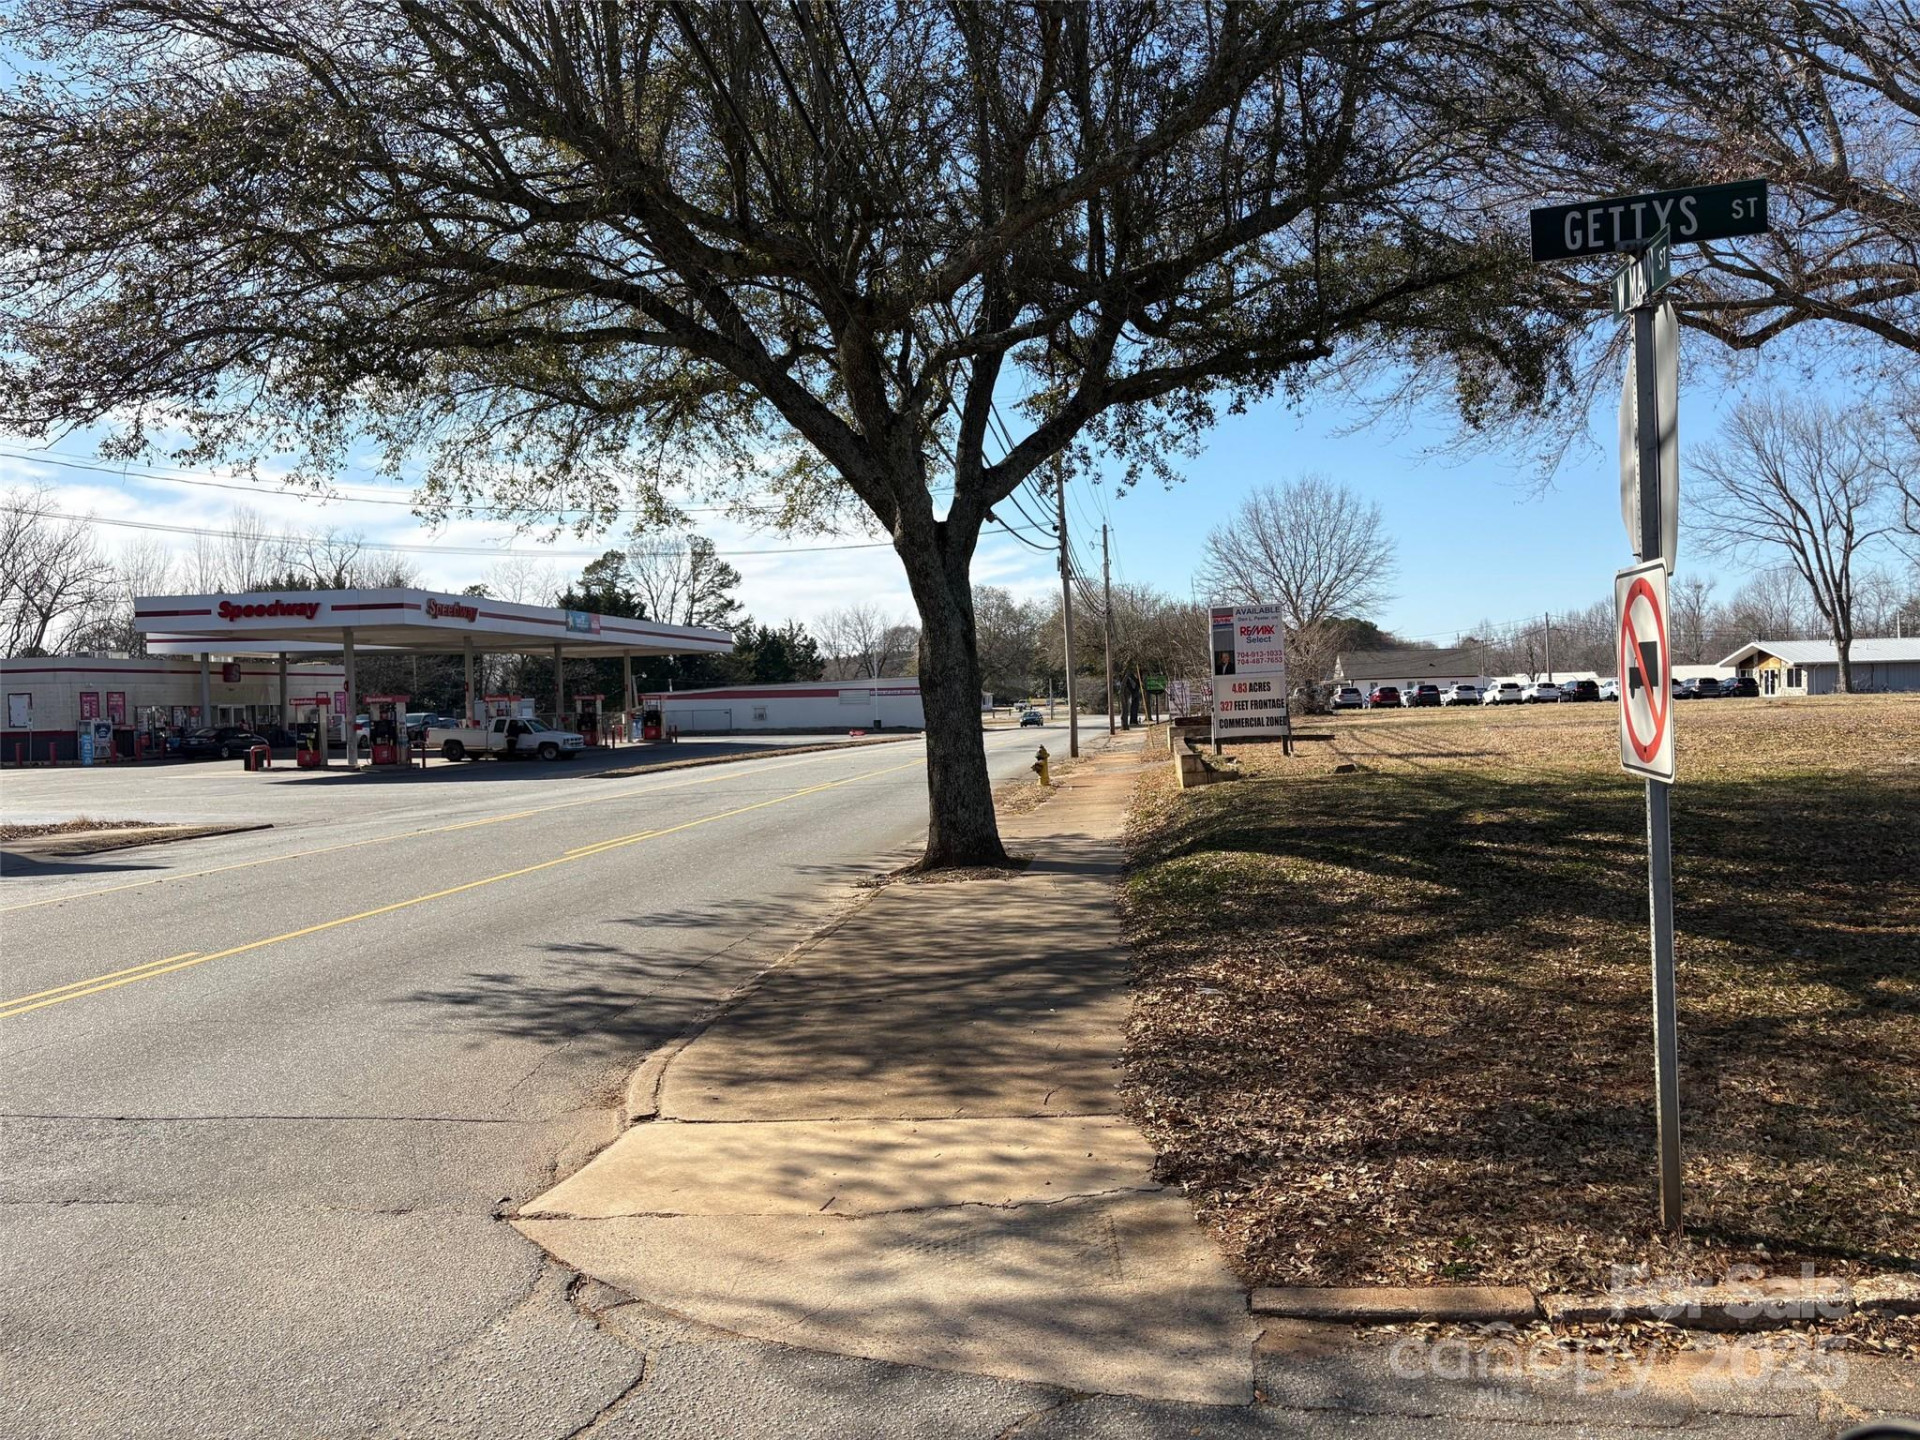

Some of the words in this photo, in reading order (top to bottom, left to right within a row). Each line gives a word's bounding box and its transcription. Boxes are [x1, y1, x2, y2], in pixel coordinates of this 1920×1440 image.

[1564, 196, 1698, 250] GETTYS
[1731, 196, 1758, 219] ST
[1617, 272, 1625, 313] W
[1629, 246, 1655, 308] MAIN
[1658, 245, 1667, 270] ST
[218, 600, 321, 622] Speedway
[426, 598, 479, 623] Speedway
[1236, 606, 1281, 615] AVAILABLE
[1240, 624, 1275, 636] RE/MAX
[1246, 635, 1272, 644] Select
[1232, 682, 1248, 694] 4.83
[1249, 681, 1271, 692] ACRES
[1220, 700, 1233, 711] 327
[1234, 700, 1249, 711] FEET
[1250, 698, 1285, 710] FRONTAGE
[1219, 716, 1265, 729] COMMERCIAL
